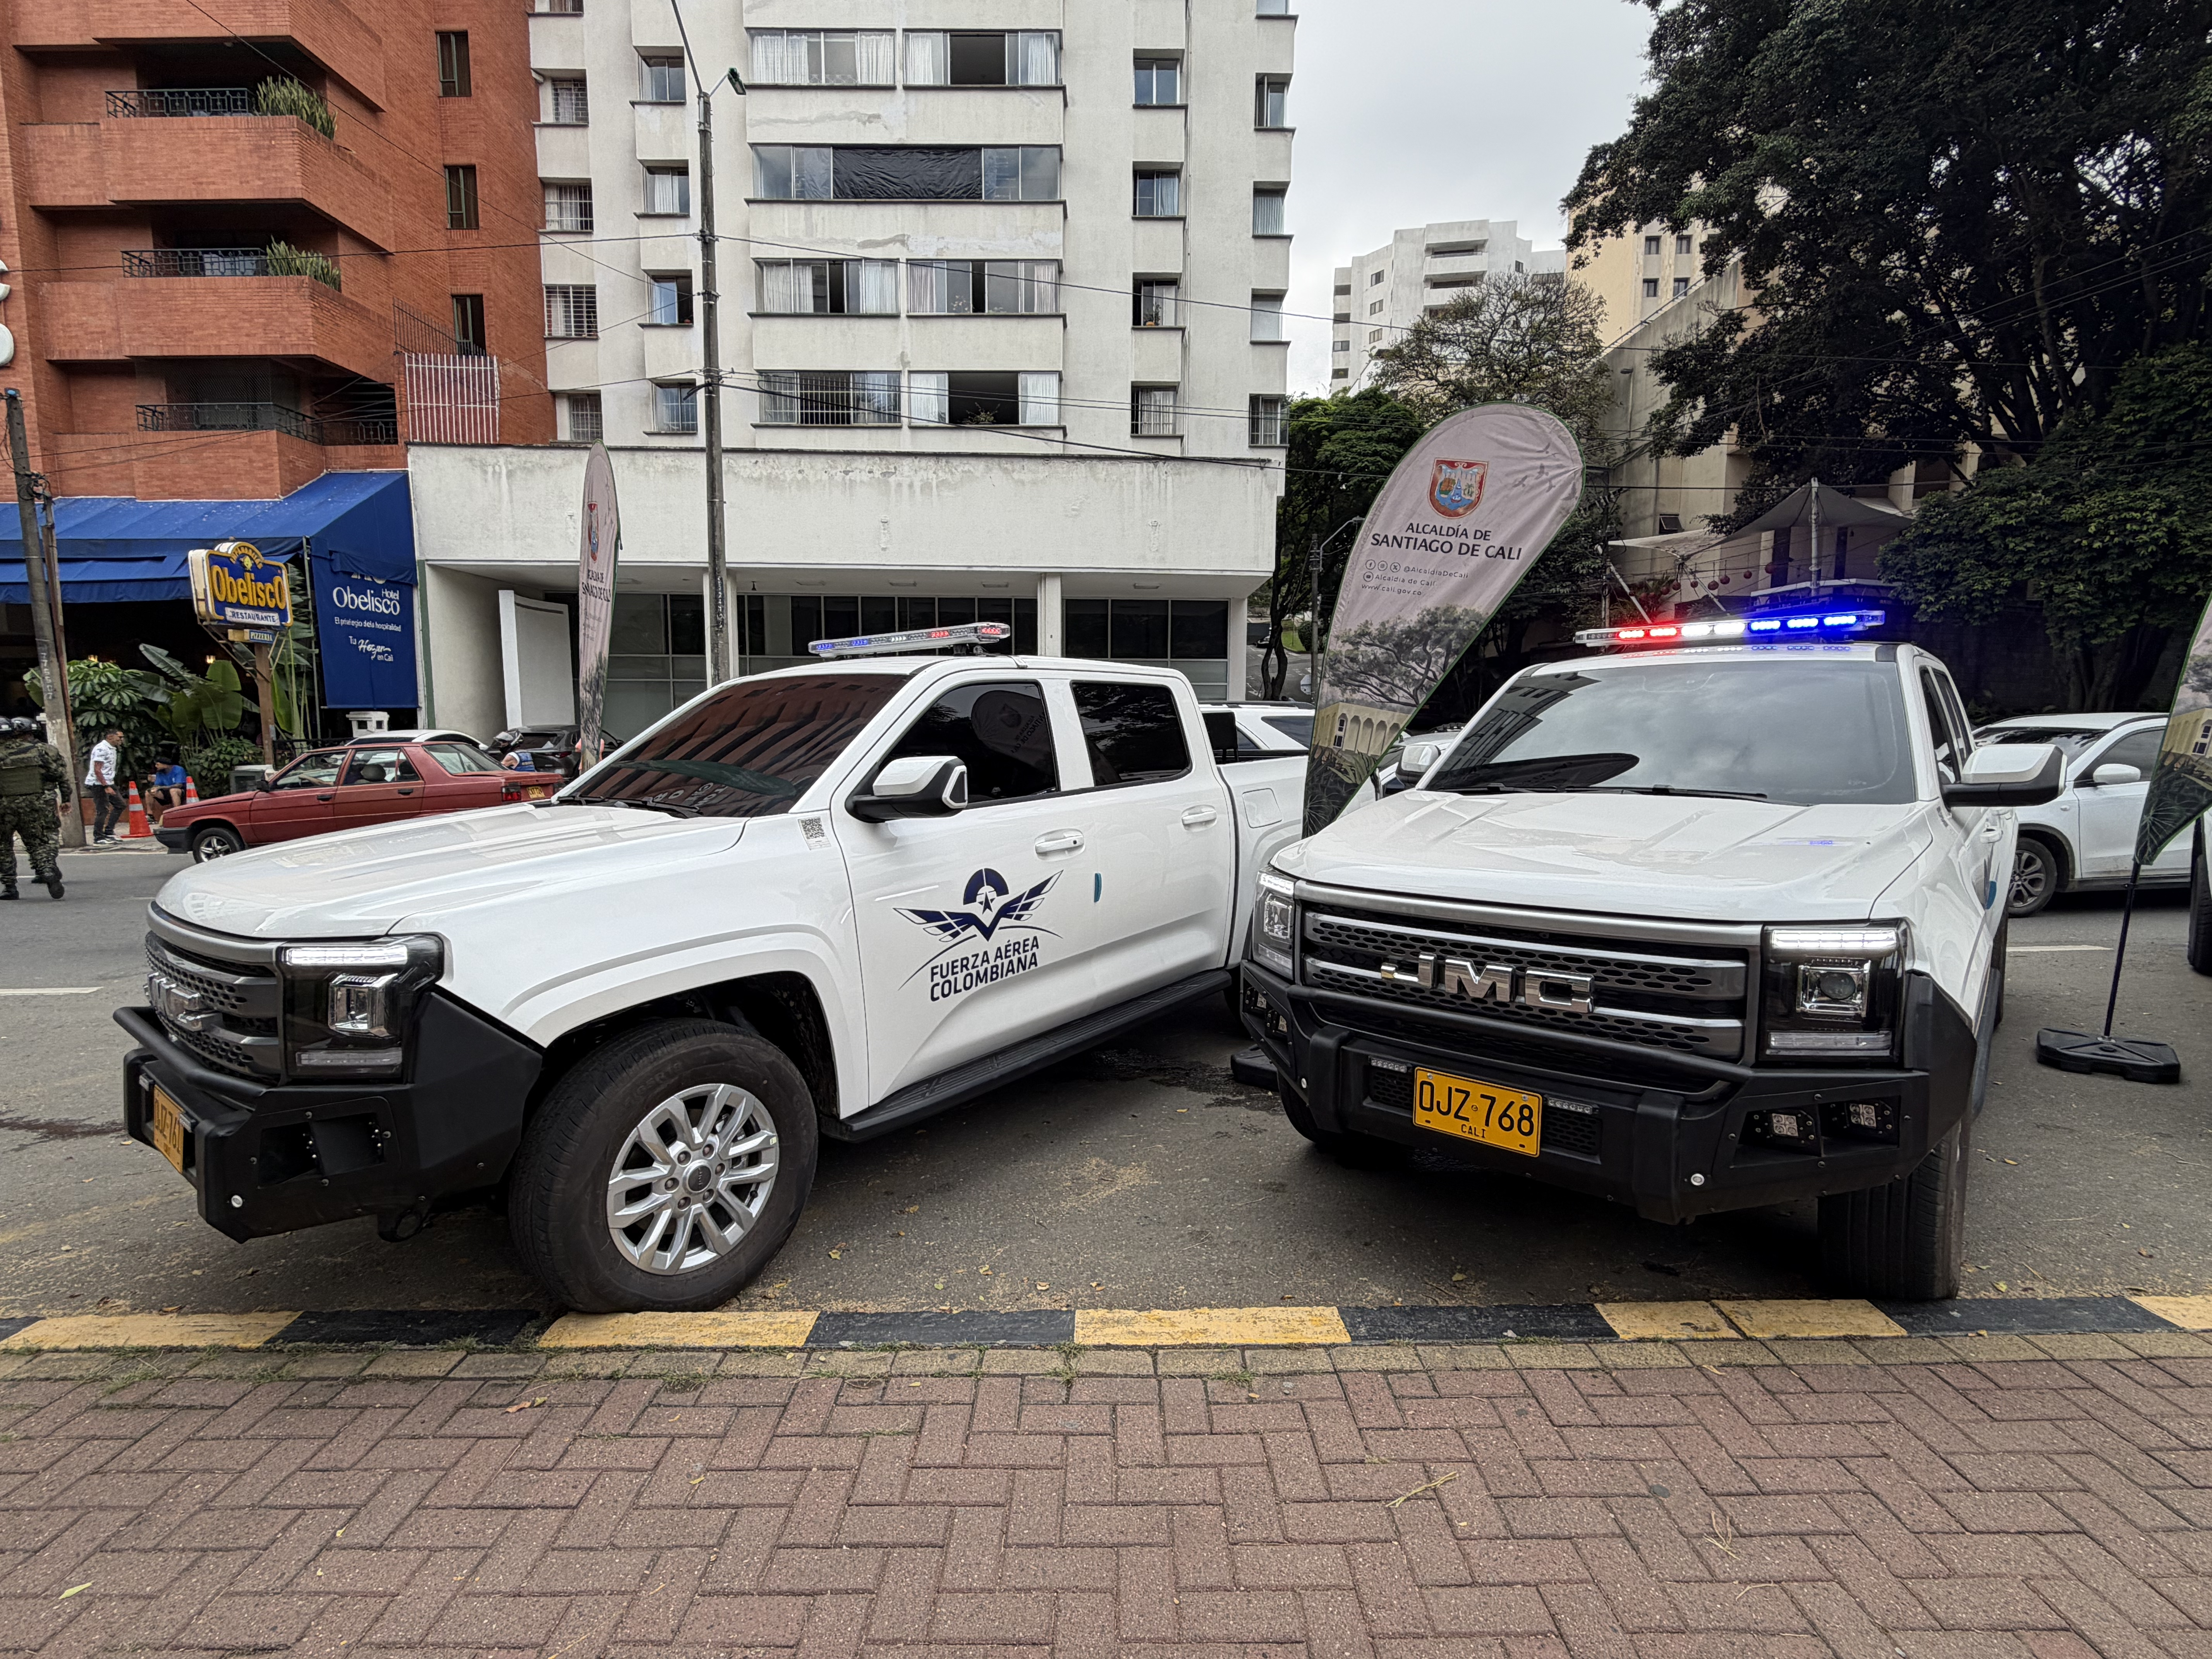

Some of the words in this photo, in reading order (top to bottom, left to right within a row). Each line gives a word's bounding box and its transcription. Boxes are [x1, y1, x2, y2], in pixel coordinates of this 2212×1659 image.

[1405, 522, 1468, 539] ALCALDÍA
[1473, 529, 1492, 541] DE
[1371, 533, 1453, 554] SANTIAGO
[1458, 542, 1481, 557] DE
[1485, 545, 1522, 560] CALI
[333, 586, 400, 615] Obelisco
[382, 588, 399, 600] Hotel
[231, 611, 276, 622] RESTAURANTE
[349, 635, 356, 644] Tu
[384, 654, 393, 662] Cali
[931, 950, 990, 982] FUERZA
[994, 936, 1039, 963] AÉREA
[930, 952, 1038, 1002] COLOMBIANA
[1381, 952, 1594, 1013] JMC
[1461, 1123, 1487, 1139] CALI
